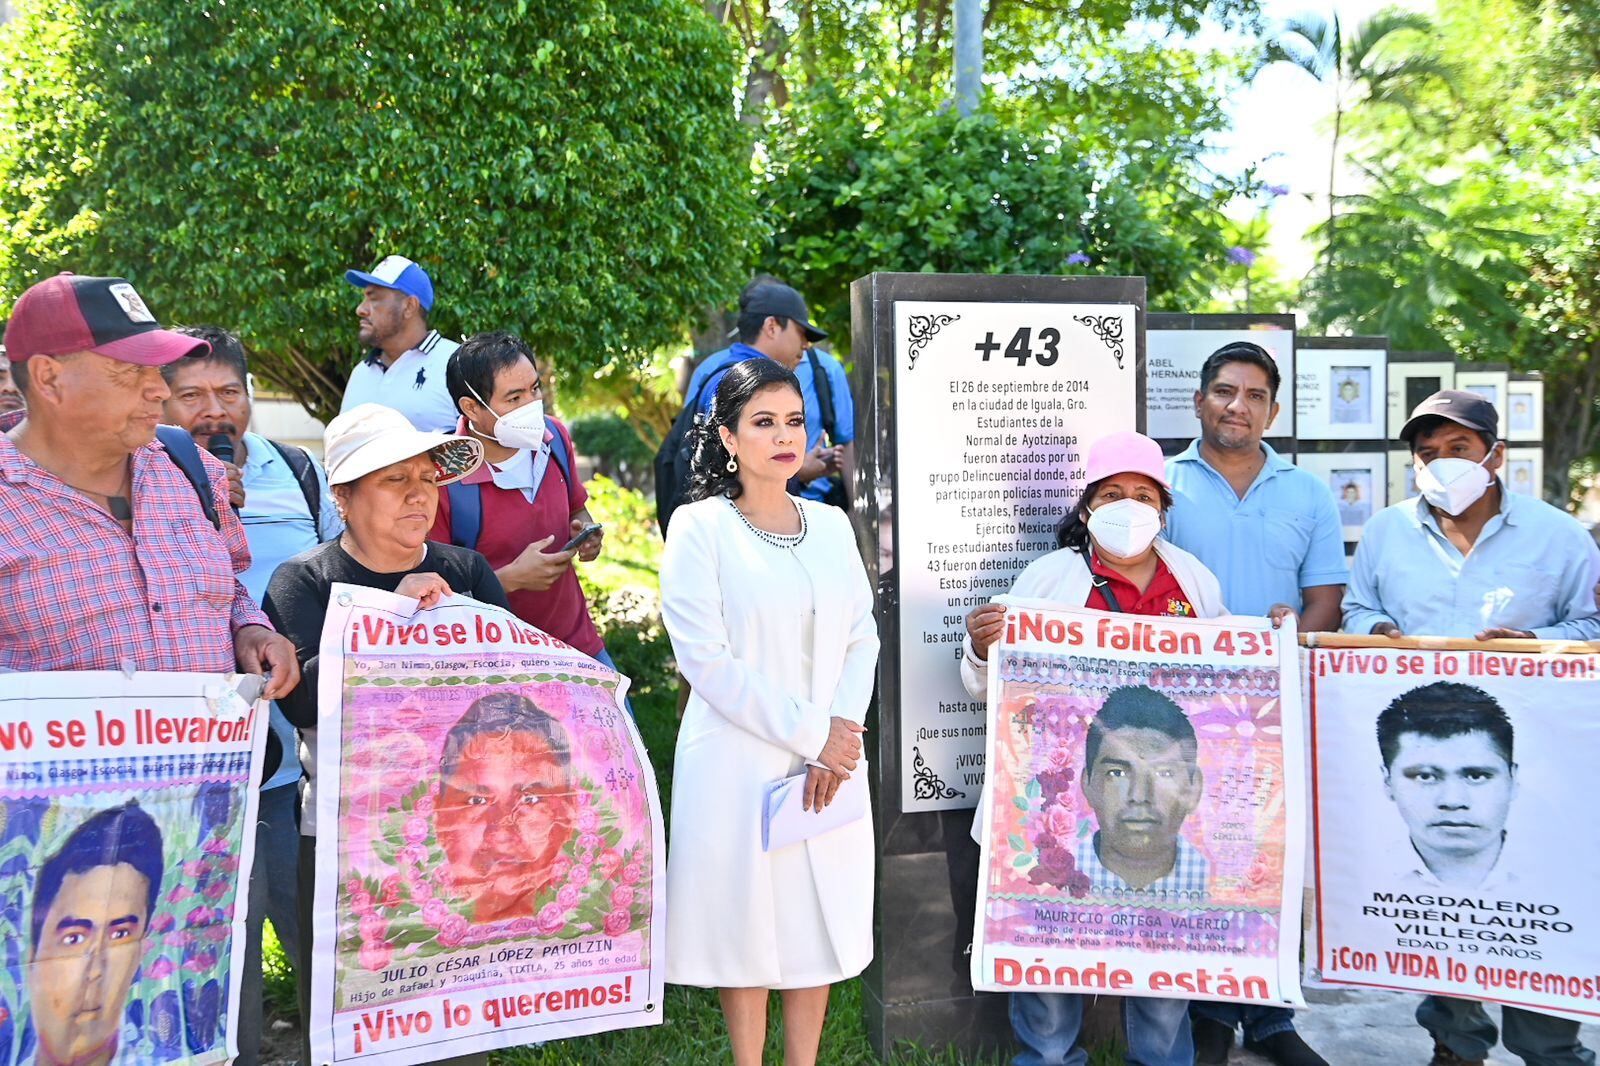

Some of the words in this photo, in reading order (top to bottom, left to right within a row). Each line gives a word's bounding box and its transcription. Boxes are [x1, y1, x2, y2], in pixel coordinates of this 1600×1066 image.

[975, 327, 1060, 366] +43
[1149, 359, 1174, 368] ABEL
[950, 381, 959, 393] El
[962, 382, 974, 392] 26
[977, 381, 988, 392] de
[992, 381, 1048, 395] septiembre
[1052, 381, 1063, 391] de
[1067, 381, 1089, 392] 2014
[953, 402, 964, 410] en
[968, 399, 976, 410] la
[979, 399, 1013, 410] ciudad
[1017, 399, 1028, 410] de
[1032, 399, 1065, 412] Iguala,
[1067, 399, 1087, 409] Gro.
[978, 417, 1037, 428] Estudiantes
[1040, 417, 1052, 427] de
[1054, 416, 1063, 427] la
[966, 434, 1002, 446] Normal
[1005, 434, 1017, 445] de
[1022, 433, 1077, 448] Ayotzinapa
[964, 452, 997, 464] fueron
[1000, 452, 1046, 463] atacados
[1049, 454, 1065, 466] por
[1068, 454, 1079, 462] un
[929, 472, 959, 484] grupo
[963, 469, 1031, 482] Delincuencial
[1034, 469, 1067, 482] donde,
[936, 489, 1000, 502] participaron
[1003, 486, 1041, 499] policías
[961, 506, 1011, 518] Estatales,
[1014, 505, 1062, 516] Federales
[1066, 507, 1070, 517] y
[976, 522, 1015, 536] Ejército
[928, 543, 950, 554] Tres
[953, 541, 1013, 553] estudiantes
[1016, 540, 1049, 552] fueron
[928, 561, 940, 572] 43
[943, 560, 976, 572] fueron
[940, 578, 967, 589] Estos
[970, 576, 1008, 592] jóvenes
[948, 597, 960, 607] un
[944, 616, 962, 626] que
[351, 614, 428, 652] ¡Vivo
[435, 624, 467, 646] se
[475, 614, 502, 644] lo
[924, 632, 938, 644] las
[1006, 612, 1084, 645] ¡Nos
[1097, 618, 1202, 655] faltan
[1214, 630, 1273, 656] 43!
[354, 661, 371, 671] Yo,
[379, 661, 396, 669] Jan
[473, 660, 515, 668] Escocia,
[521, 660, 550, 668] quiero
[1006, 658, 1018, 667] Yo
[1022, 660, 1038, 668] Jan
[1042, 661, 1071, 672] Nimmo,
[1076, 664, 1112, 676] Glasgow,
[1319, 650, 1388, 676] ¡Vivo
[1396, 654, 1424, 674] se
[1434, 652, 1458, 676] lo
[1468, 652, 1595, 678] llevaron!
[939, 701, 967, 714] hasta
[970, 702, 987, 714] que
[47, 719, 86, 748] se
[95, 710, 126, 746] lo
[135, 708, 254, 745] llevaron!
[916, 727, 939, 741] ¡Que
[942, 727, 958, 737] sus
[1221, 822, 1246, 830] SOMOS
[1373, 892, 1560, 916] MAGDALENO
[1034, 909, 1103, 925] MAURICIO
[1112, 914, 1162, 928] ORTEGA
[1170, 918, 1230, 930] VALERIO
[1363, 906, 1459, 923] RUBÉN
[1470, 914, 1573, 933] LAURO
[1038, 925, 1058, 934] Hijo
[1063, 926, 1073, 934] de
[1206, 933, 1224, 941] Años
[1395, 924, 1538, 946] VILLEGAS
[1030, 935, 1060, 945] origen
[1116, 938, 1141, 948] Monte
[1397, 938, 1448, 950] EDAD
[1458, 944, 1478, 953] 19
[1486, 946, 1542, 960] AÑOS
[380, 965, 427, 984] JULIO
[436, 955, 480, 973] CÉSAR
[490, 948, 533, 964] LÓPEZ
[542, 940, 612, 958] PATOLZIN
[1332, 946, 1377, 972] ¡Con
[1385, 951, 1440, 980] VIDA
[1447, 957, 1467, 982] lo
[350, 992, 376, 1003] Hijo
[382, 988, 394, 997] de
[400, 979, 434, 994] Rafael
[440, 978, 446, 987] y
[554, 962, 564, 970] 25
[571, 960, 592, 968] años
[598, 957, 609, 965] de
[615, 955, 636, 963] edad
[994, 958, 1133, 989] Dónde
[1149, 967, 1269, 999] están
[354, 1009, 432, 1053] ¡Vivo
[443, 999, 471, 1028] lo
[482, 976, 632, 1028] queremos!
